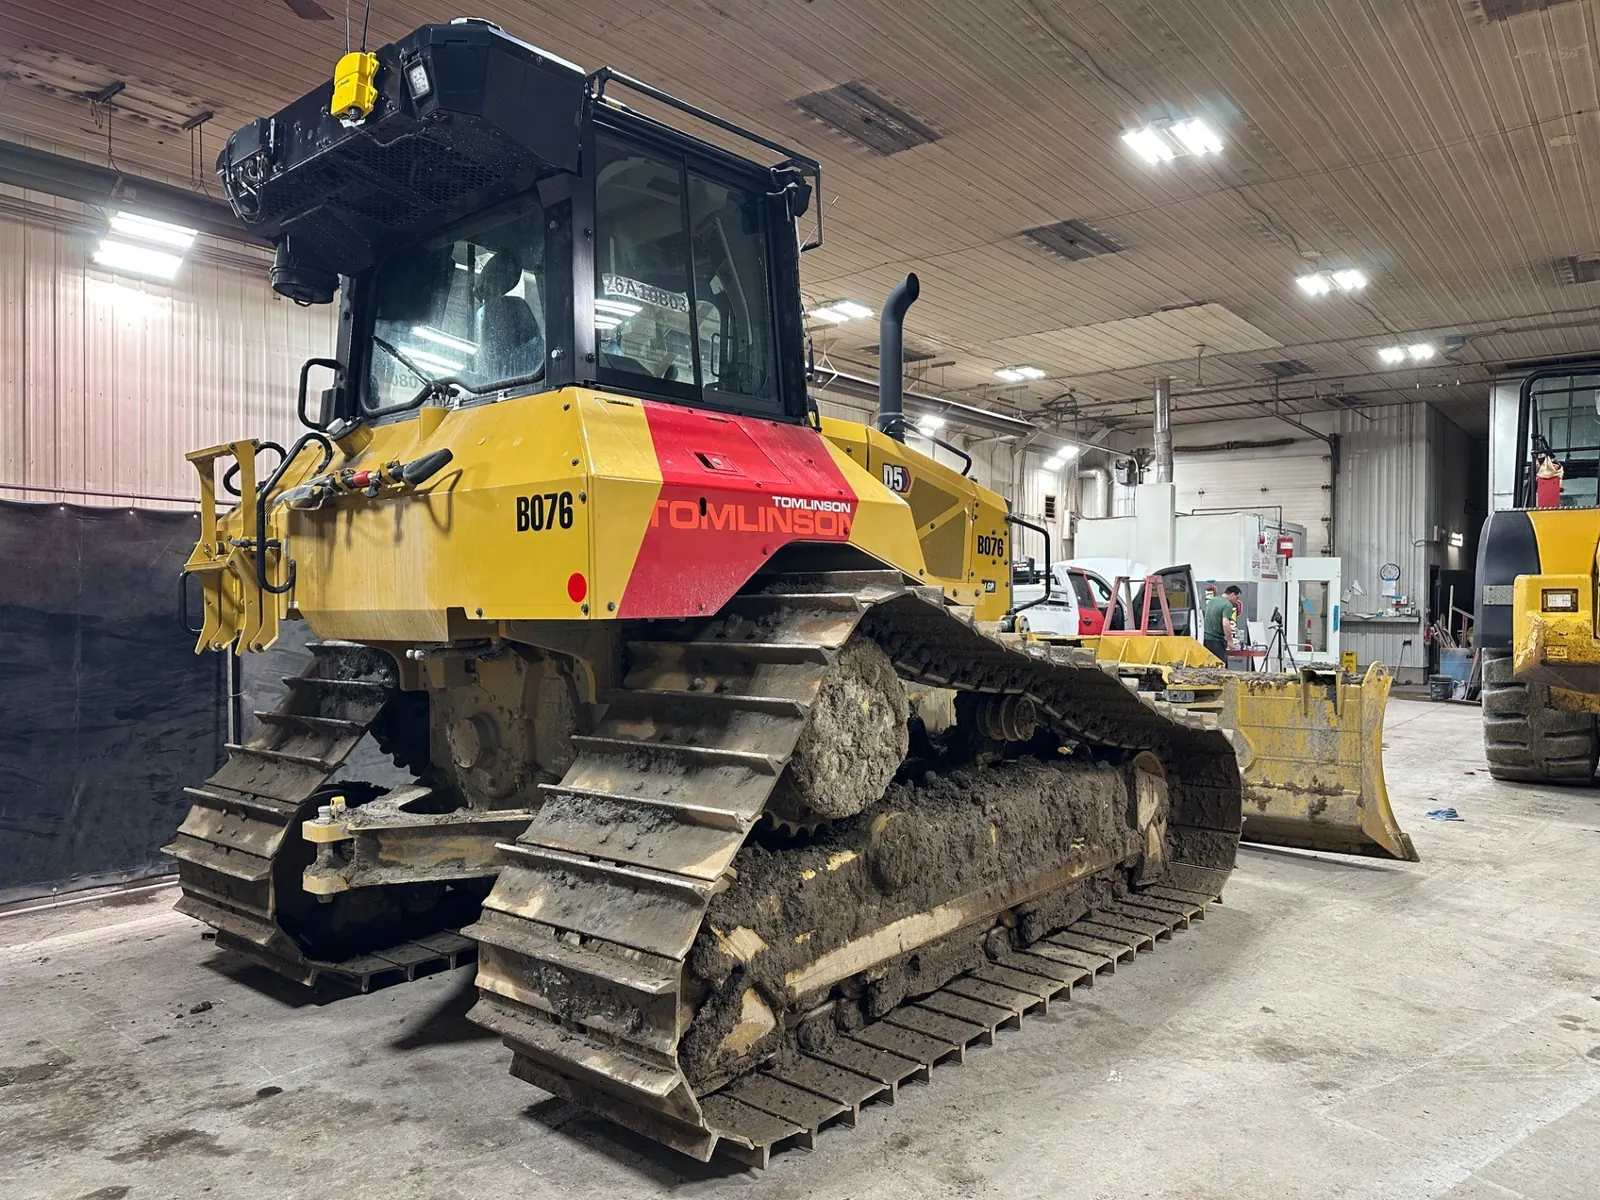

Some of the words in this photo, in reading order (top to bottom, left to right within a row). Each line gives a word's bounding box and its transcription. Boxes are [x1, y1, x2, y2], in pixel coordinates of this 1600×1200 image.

[883, 464, 903, 491] D5
[516, 491, 574, 532] B076
[772, 496, 851, 513] TOMLINSON
[977, 534, 1004, 558] B076
